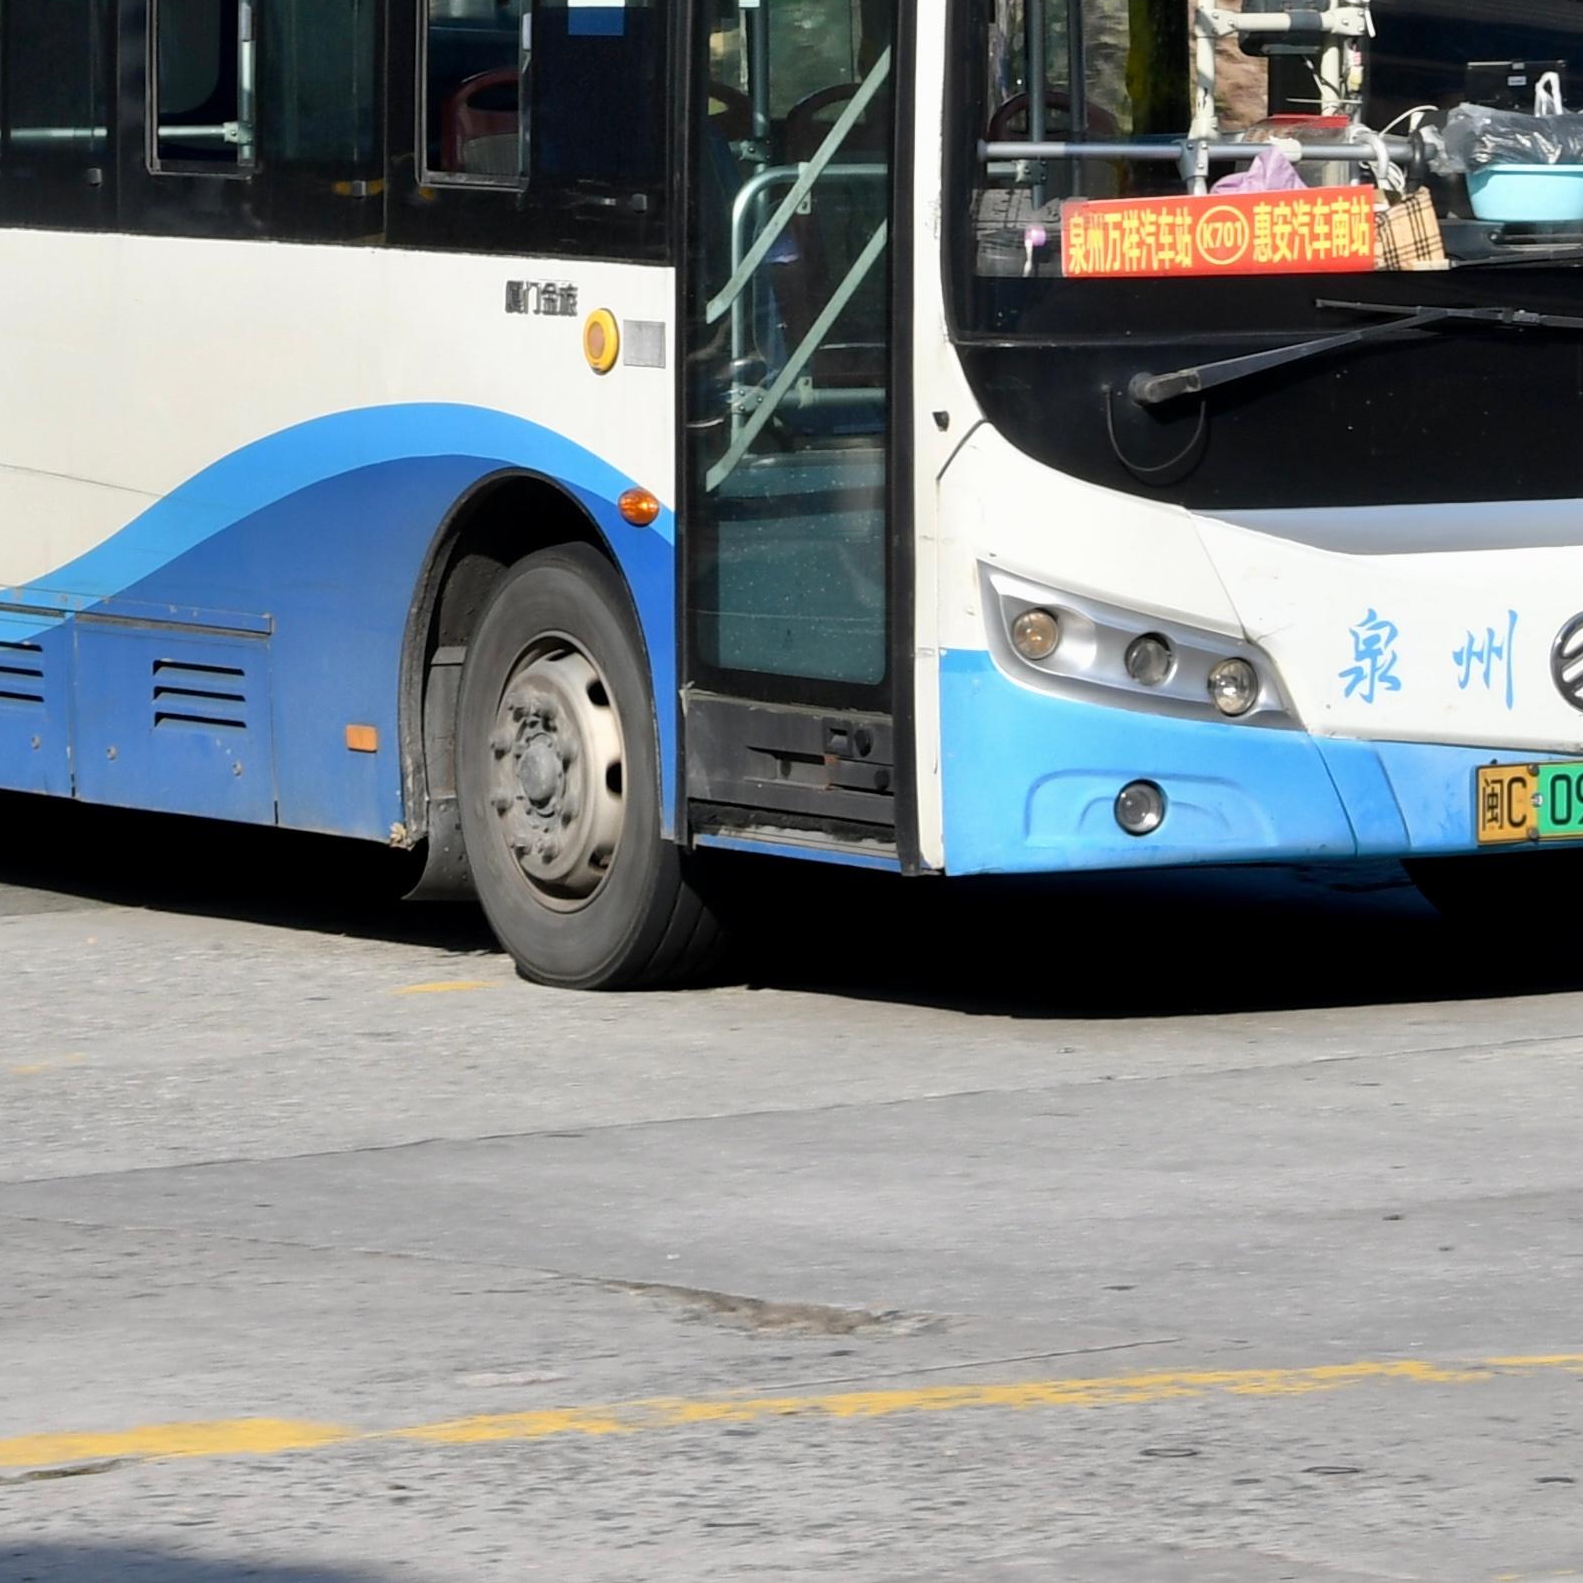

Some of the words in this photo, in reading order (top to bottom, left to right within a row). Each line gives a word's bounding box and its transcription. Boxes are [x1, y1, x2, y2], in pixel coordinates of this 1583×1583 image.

[1069, 207, 1193, 275] 泉州万祥汽车站
[1202, 220, 1244, 249] K701
[1253, 196, 1371, 264] 惠安汽车南站
[505, 279, 578, 316] 厦门金旅
[1338, 607, 1518, 711] 泉州
[1481, 774, 1528, 831] 闽C
